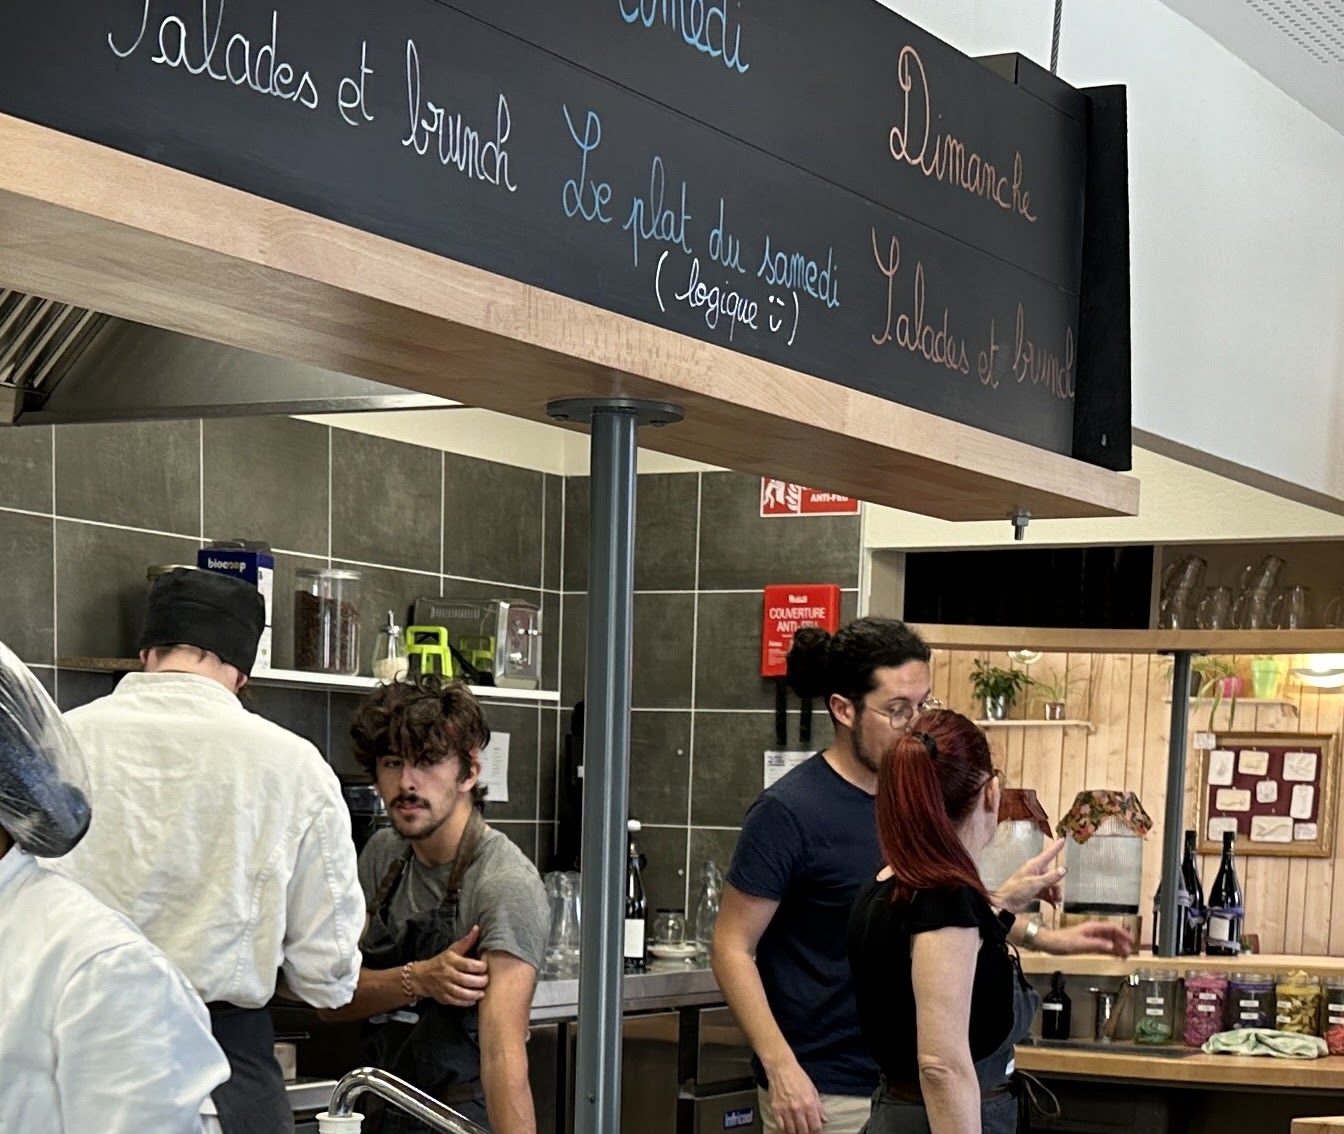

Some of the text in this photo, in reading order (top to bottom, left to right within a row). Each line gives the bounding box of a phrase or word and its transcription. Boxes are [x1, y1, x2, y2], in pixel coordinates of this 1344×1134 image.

[338, 40, 374, 127] et
[402, 40, 517, 192] brunch
[889, 45, 1038, 223] Dimanche
[562, 103, 840, 309] Le plat du samedi
[872, 227, 970, 377] Salades
[978, 337, 1000, 389] et
[769, 607, 825, 620] COUVERTURE
